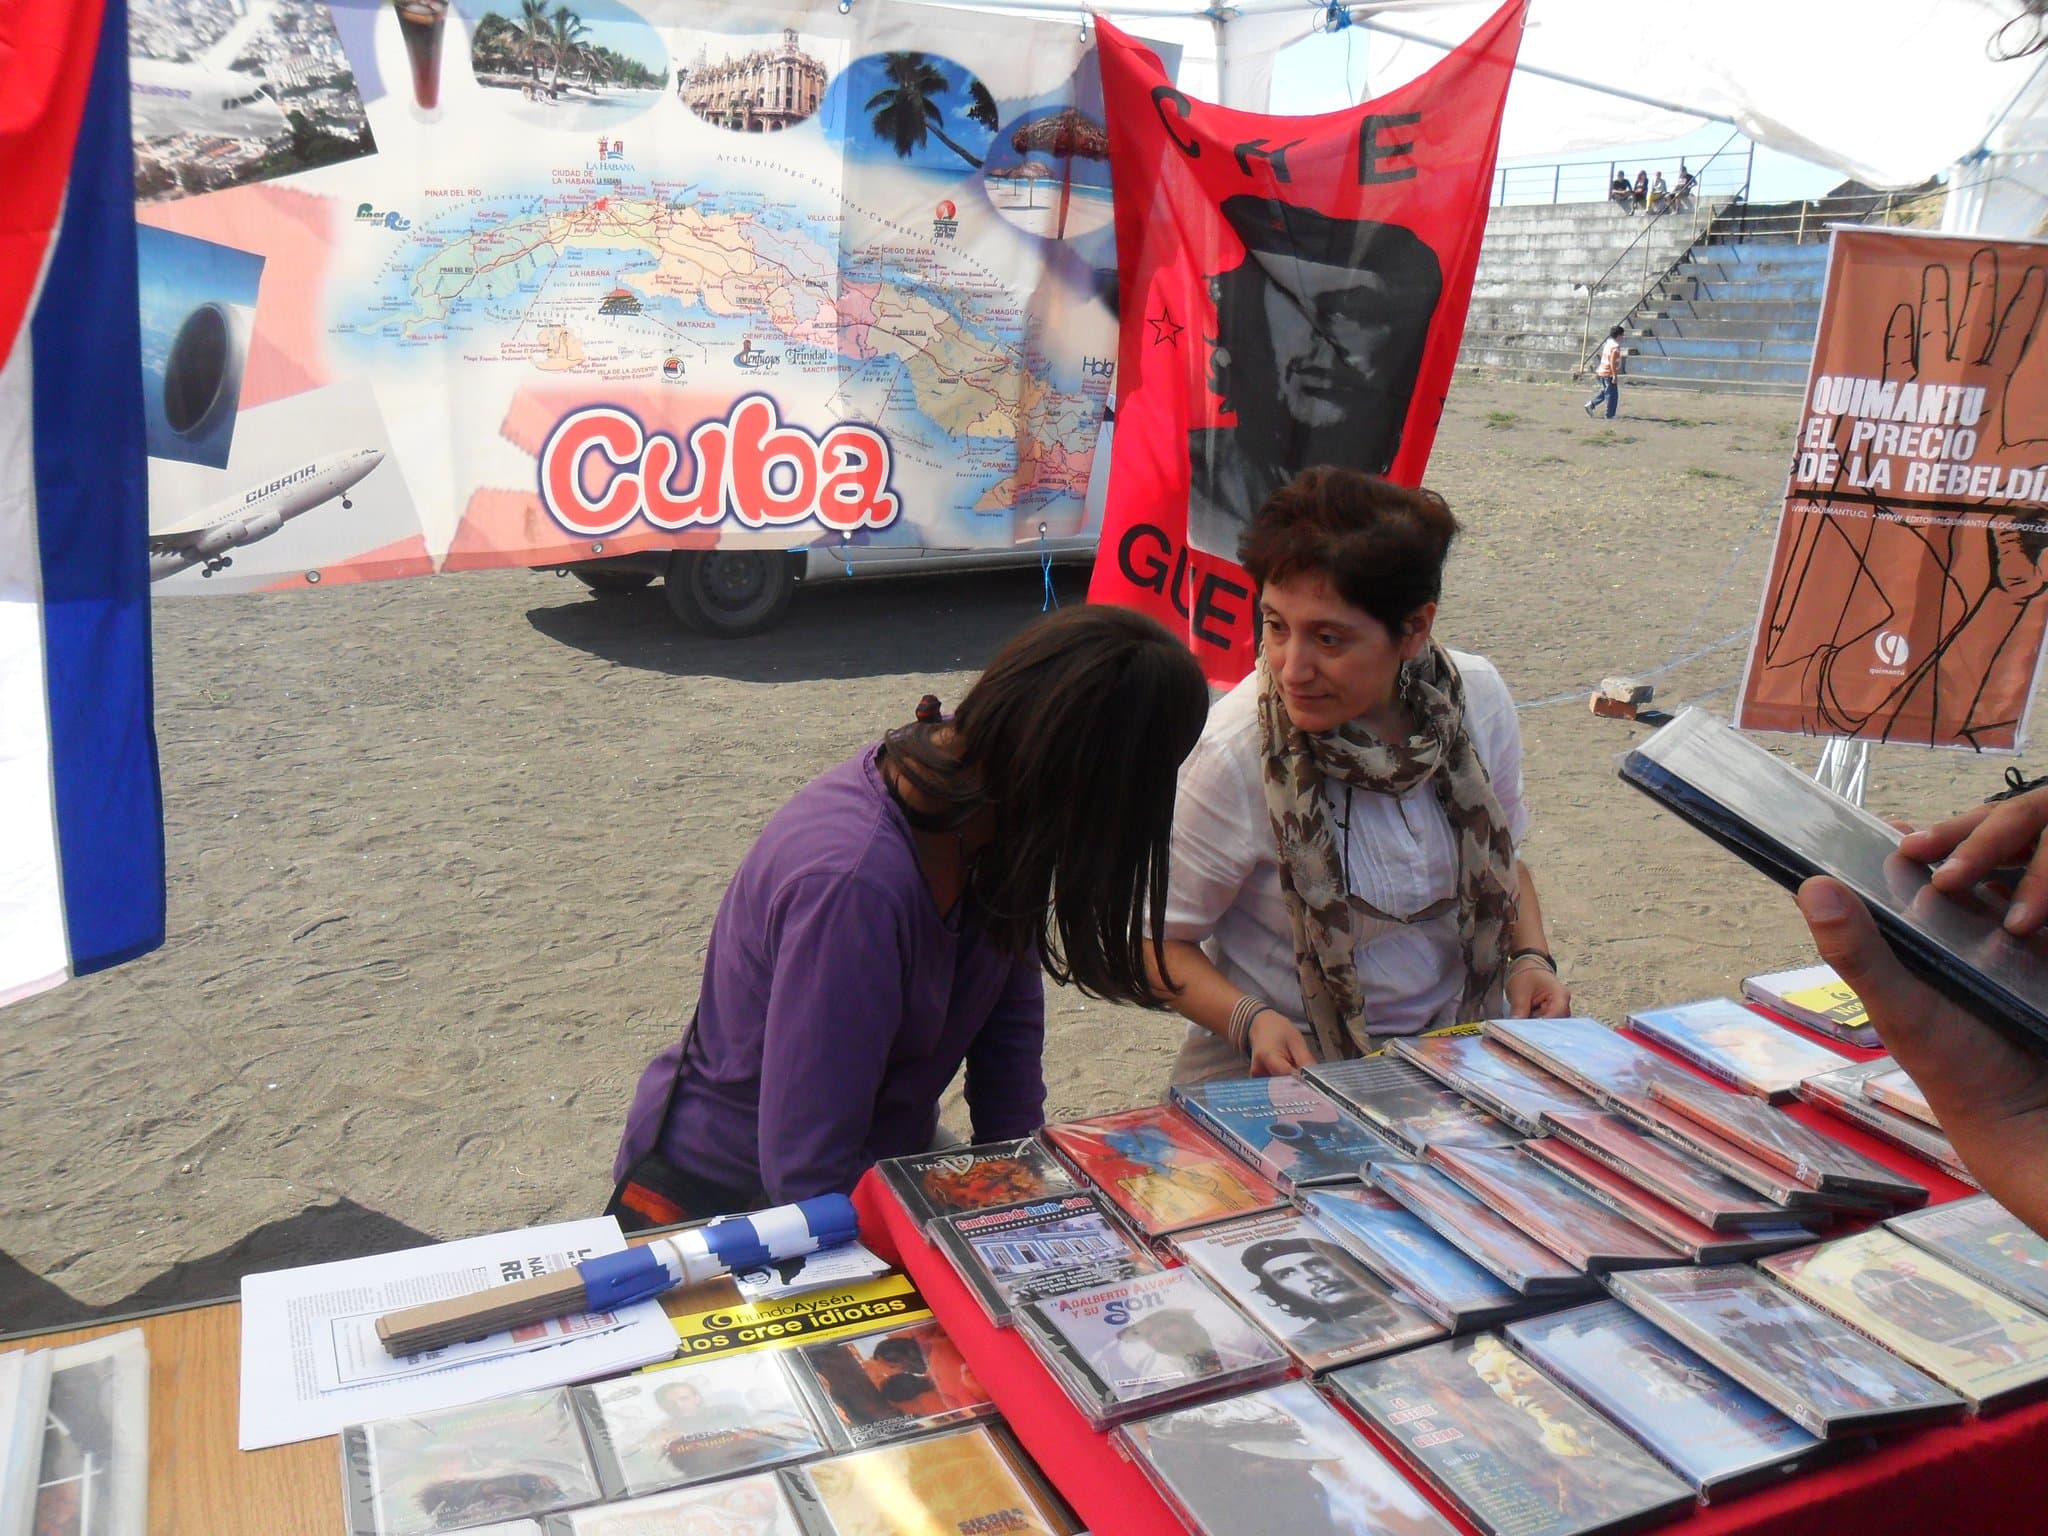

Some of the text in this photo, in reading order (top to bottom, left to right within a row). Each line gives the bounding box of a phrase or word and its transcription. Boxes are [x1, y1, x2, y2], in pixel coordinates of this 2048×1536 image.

[552, 169, 581, 177] CIUDAD
[586, 162, 636, 172] LA HABANA
[356, 203, 386, 218] Pinar
[884, 247, 905, 255] CIEGO
[985, 308, 1023, 316] CAMAGÜEY
[676, 321, 716, 329] MATANZAS
[743, 333, 789, 341] CIENFUEGOS
[785, 348, 828, 365] Trinidad
[1810, 375, 1986, 426] QUIMANTU
[1804, 418, 1978, 461] EL PRECIO
[543, 396, 899, 534] Cuba
[1796, 451, 1839, 485] DE
[1847, 456, 1892, 489] LA
[245, 463, 316, 504] CUBANA
[956, 1211, 1011, 1230] Canciones
[1011, 1208, 1026, 1220] de
[500, 1260, 525, 1282] RE
[1071, 1308, 1080, 1319] Y
[1083, 1305, 1099, 1316] SU
[738, 1319, 803, 1343] cree
[807, 1298, 907, 1329] idiotas
[852, 1423, 873, 1433] SILVIO
